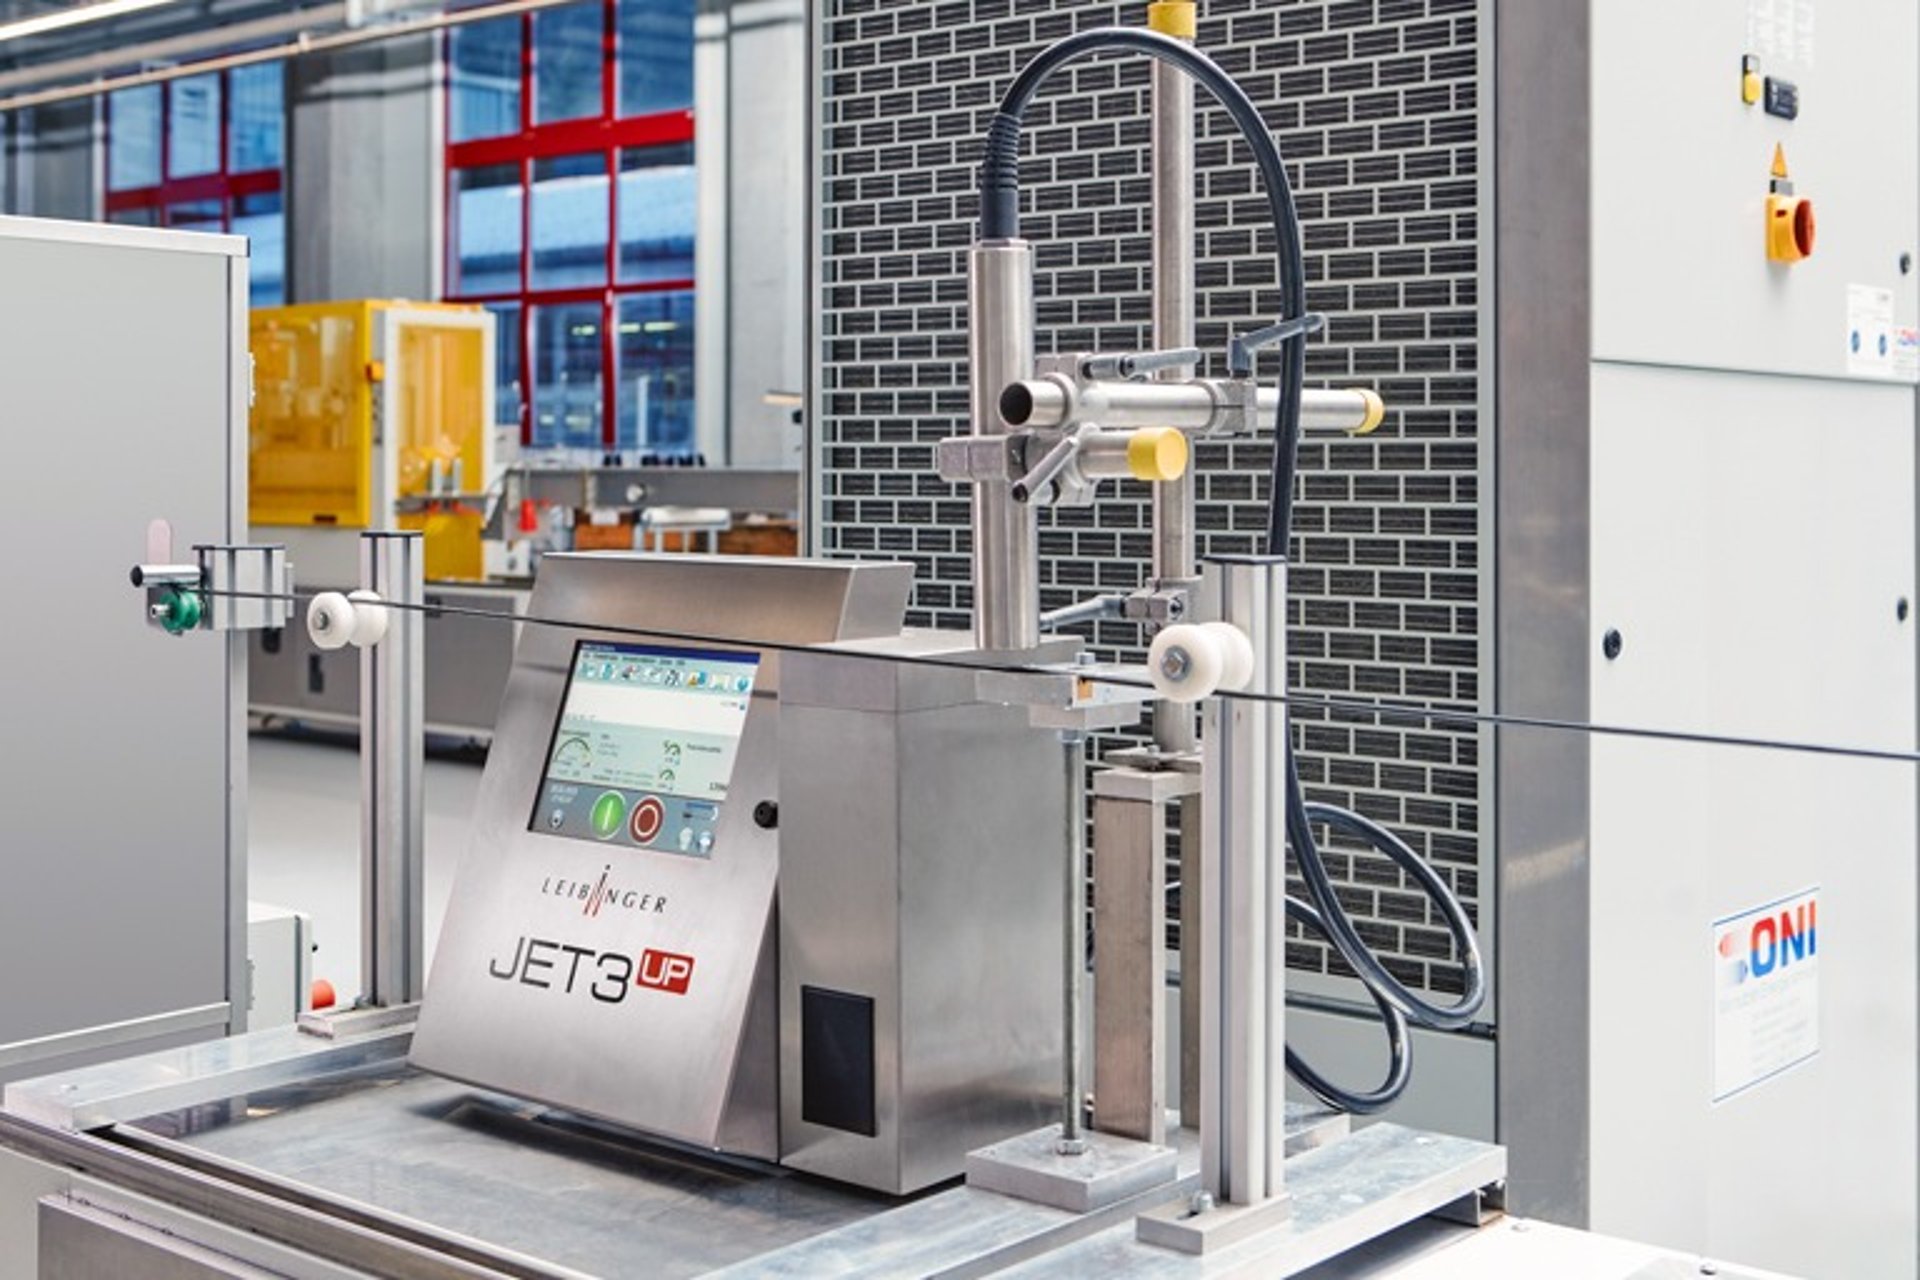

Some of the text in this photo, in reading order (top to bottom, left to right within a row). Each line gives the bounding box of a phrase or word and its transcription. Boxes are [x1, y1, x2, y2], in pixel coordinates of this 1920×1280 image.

[489, 936, 690, 1003] JET3 UP
[1750, 900, 1816, 978] ONI
